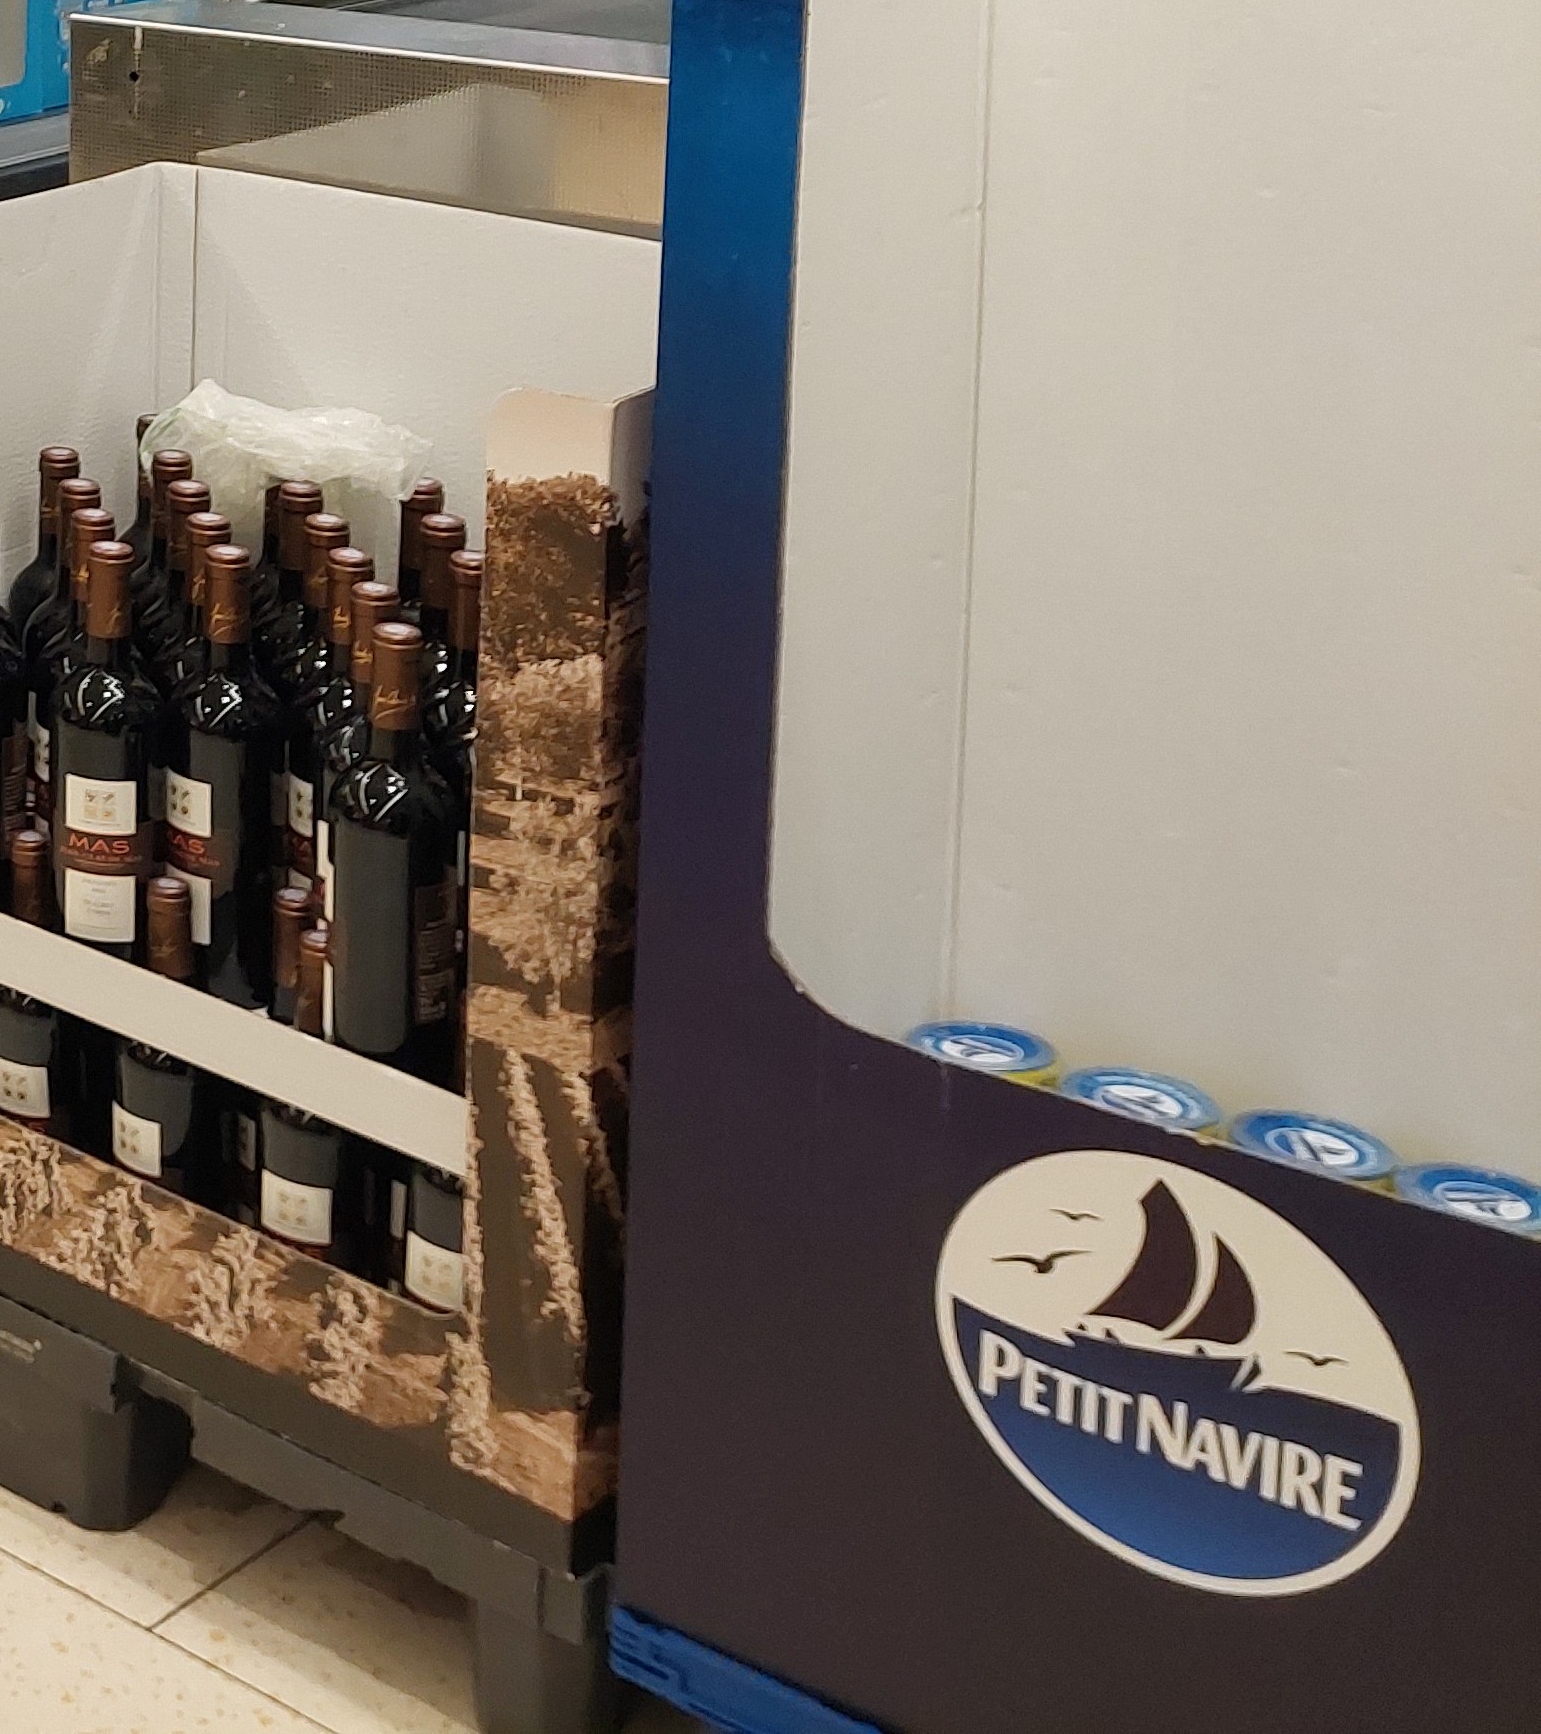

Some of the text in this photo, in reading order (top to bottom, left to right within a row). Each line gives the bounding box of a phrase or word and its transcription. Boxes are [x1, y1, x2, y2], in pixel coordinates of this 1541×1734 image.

[69, 833, 130, 855] MAS
[172, 834, 205, 856] AS
[977, 1328, 1365, 1532] PETIT NAVIRE
